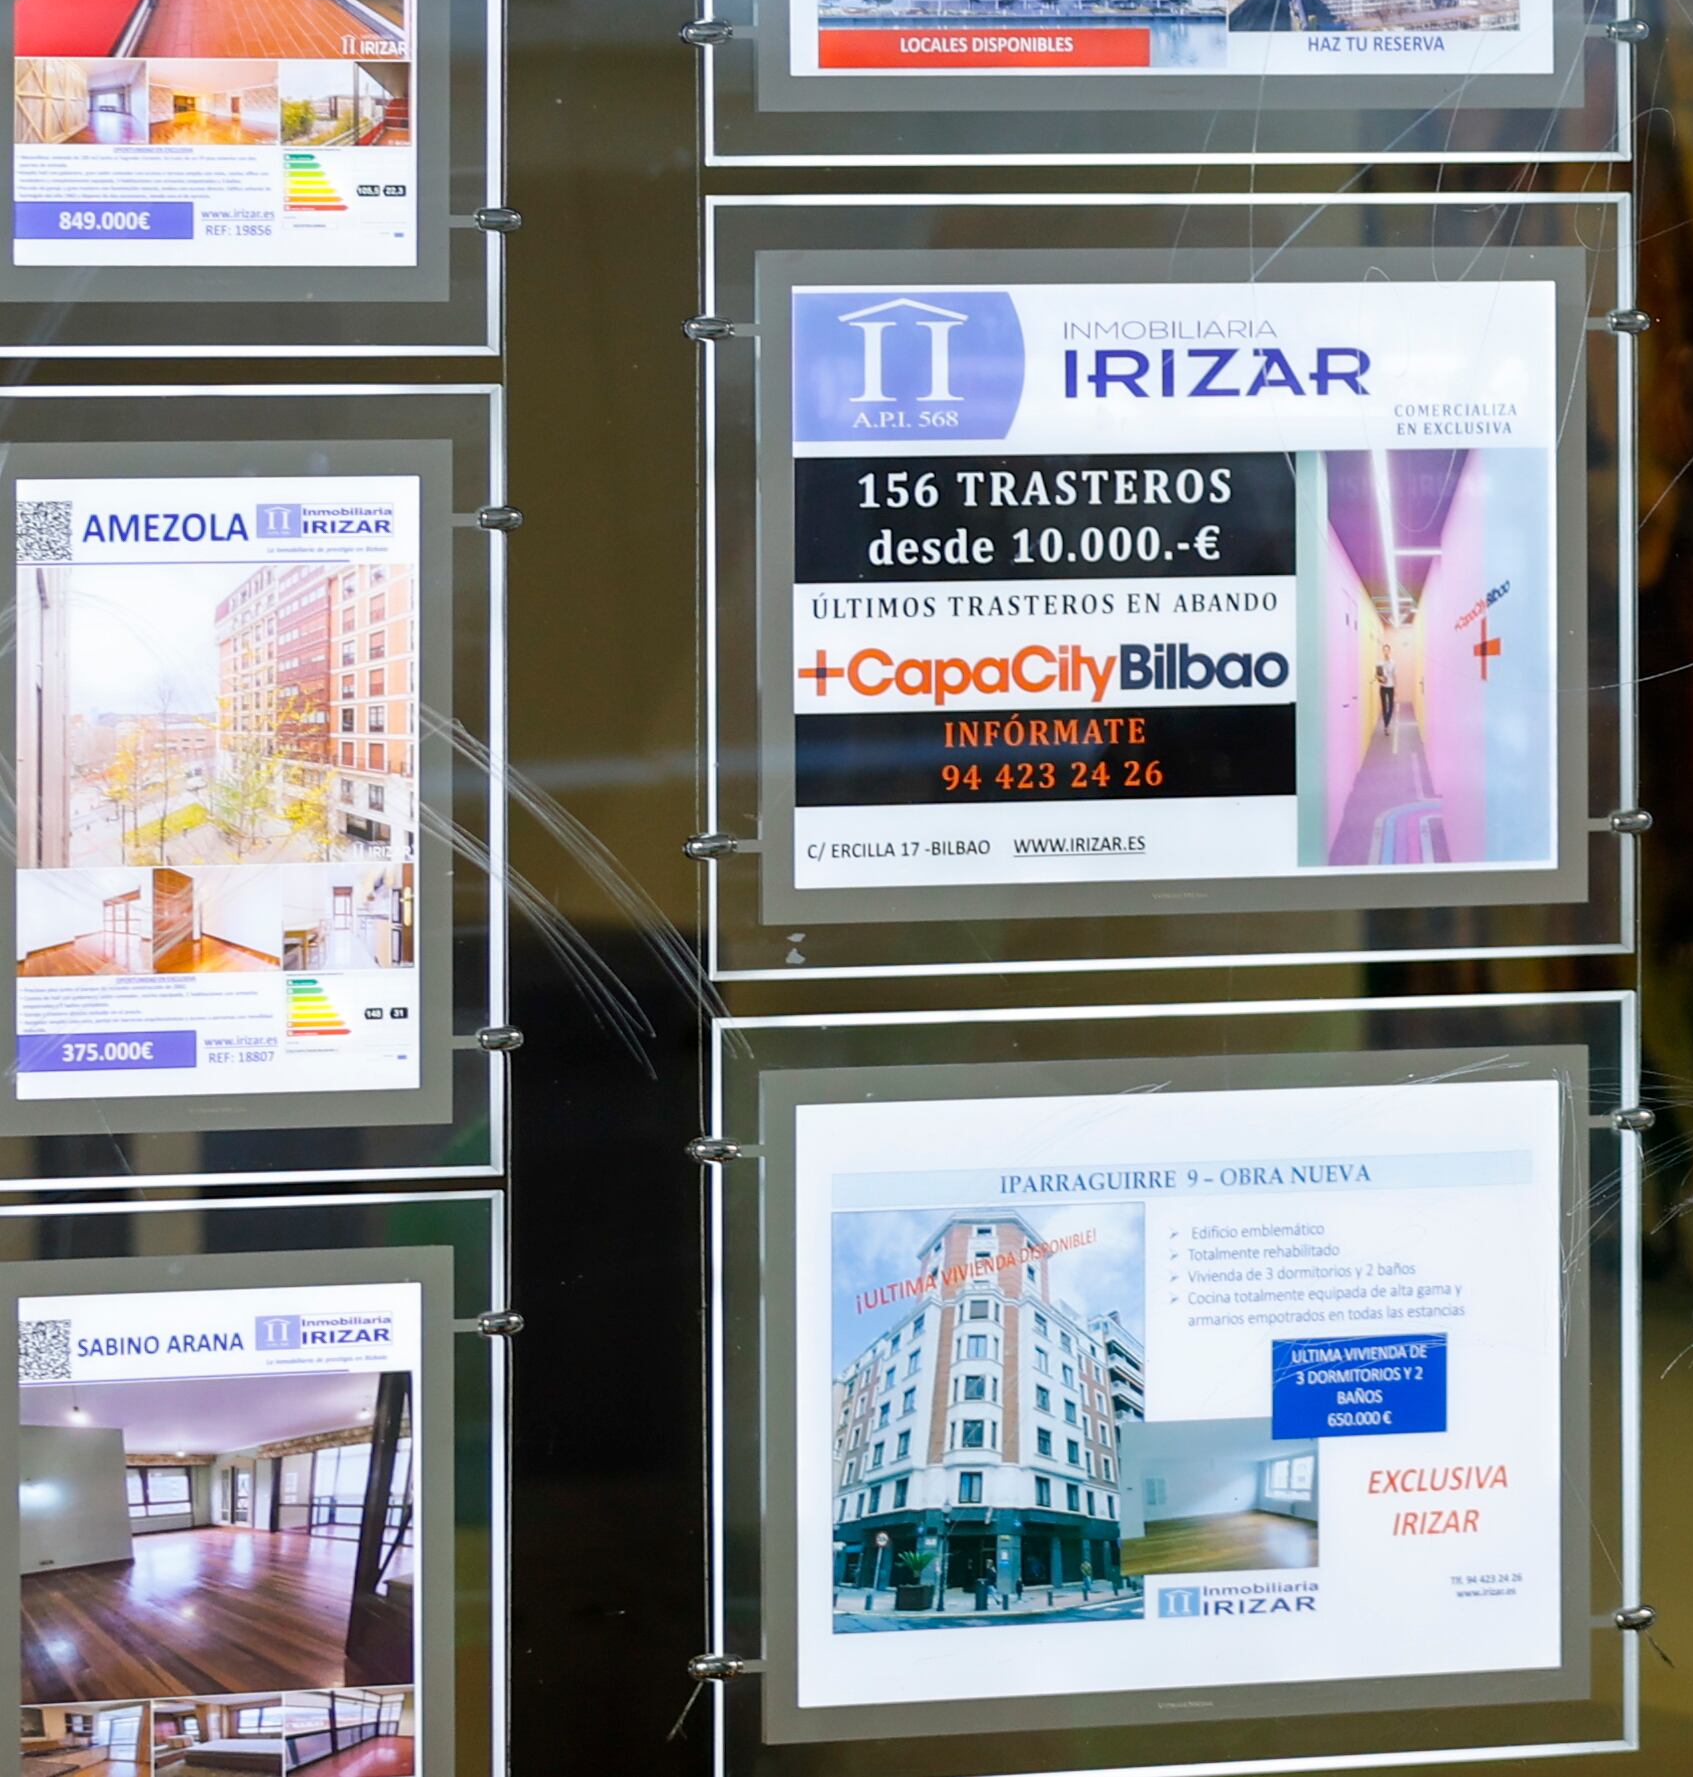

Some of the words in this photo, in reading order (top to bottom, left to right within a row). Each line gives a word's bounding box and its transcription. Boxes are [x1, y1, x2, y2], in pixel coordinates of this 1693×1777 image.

[900, 37, 968, 52] LOCALES
[972, 37, 1073, 52] DISPONIBLES
[1308, 37, 1340, 51] HAZ
[1345, 37, 1367, 51] TU
[1374, 36, 1445, 51] RESERVA
[59, 212, 150, 230] 849.000€
[201, 209, 275, 221] www.irizar.es
[206, 225, 231, 236] REF:
[236, 225, 272, 236] 19856
[1064, 320, 1277, 340] INMOBILIARIA
[1065, 348, 1370, 398] IRIZAR
[852, 409, 911, 428] A.P.I.
[919, 410, 958, 427] 568
[1394, 404, 1517, 417] COMERCIALIZA
[1397, 423, 1416, 435] EN
[1424, 422, 1512, 435] EXCLUSIVA
[858, 472, 938, 508] 156
[957, 469, 1231, 506] TRASTEROS
[302, 508, 393, 516] Inmobiliaria
[83, 513, 248, 542] AMEZOLA
[303, 520, 391, 534] IRIZAR
[869, 528, 994, 565] desde
[1013, 525, 1220, 562] 10.000.-€
[813, 593, 935, 619] ÚLTIMOS
[948, 594, 1114, 616] TRASTEROS
[1128, 593, 1159, 613] EN
[1174, 592, 1277, 612] ABANDO
[945, 715, 1145, 748] INFÓRMATE
[942, 765, 981, 790] 94
[995, 763, 1055, 789] 423
[1071, 762, 1110, 788] 24
[1124, 761, 1163, 786] 26
[807, 842, 826, 861] C/
[832, 843, 895, 858] ERCILLA
[902, 842, 920, 856] 17
[1014, 836, 1145, 854] WWW.IRIZAR.ES
[204, 1037, 277, 1047] www.irizar.es
[62, 1042, 153, 1062] 375.000€
[208, 1052, 234, 1063] REF:
[239, 1051, 274, 1063] 18807
[1000, 1169, 1177, 1194] IPARRAGUIRRE
[1187, 1170, 1198, 1185] 9
[1220, 1168, 1284, 1186] OBRA
[1291, 1165, 1370, 1183] NUEVA
[1192, 1225, 1238, 1240] Edificio
[1241, 1223, 1324, 1238] emblemático
[1188, 1248, 1260, 1261] Totalmente
[1263, 1244, 1340, 1258] rehabilitado
[856, 1275, 938, 1314] ¡ULTIMA
[941, 1251, 1016, 1287] VIVIENDA
[1019, 1227, 1095, 1264] DISPONIBLE!
[301, 1316, 392, 1327] Inmobiliaria
[78, 1336, 159, 1357] SABINO
[167, 1333, 244, 1353] ARANA
[302, 1328, 389, 1344] IRIZAR
[1291, 1349, 1342, 1365] ULTIMA
[1344, 1345, 1406, 1361] VIVIENDA
[1408, 1344, 1428, 1358] DE
[1296, 1371, 1305, 1385] 3
[1307, 1367, 1400, 1384] DORMITORIOS
[1403, 1367, 1412, 1379] Y
[1414, 1366, 1423, 1380] 2
[1337, 1388, 1383, 1405] BAÑOS
[1328, 1411, 1381, 1427] 650.000
[1382, 1411, 1392, 1424] €
[1368, 1465, 1508, 1494] EXCLUSIVA
[1393, 1509, 1479, 1536] IRIZAR
[1203, 1581, 1319, 1597] Inmobiliaria
[1204, 1597, 1315, 1616] IRIZAR
